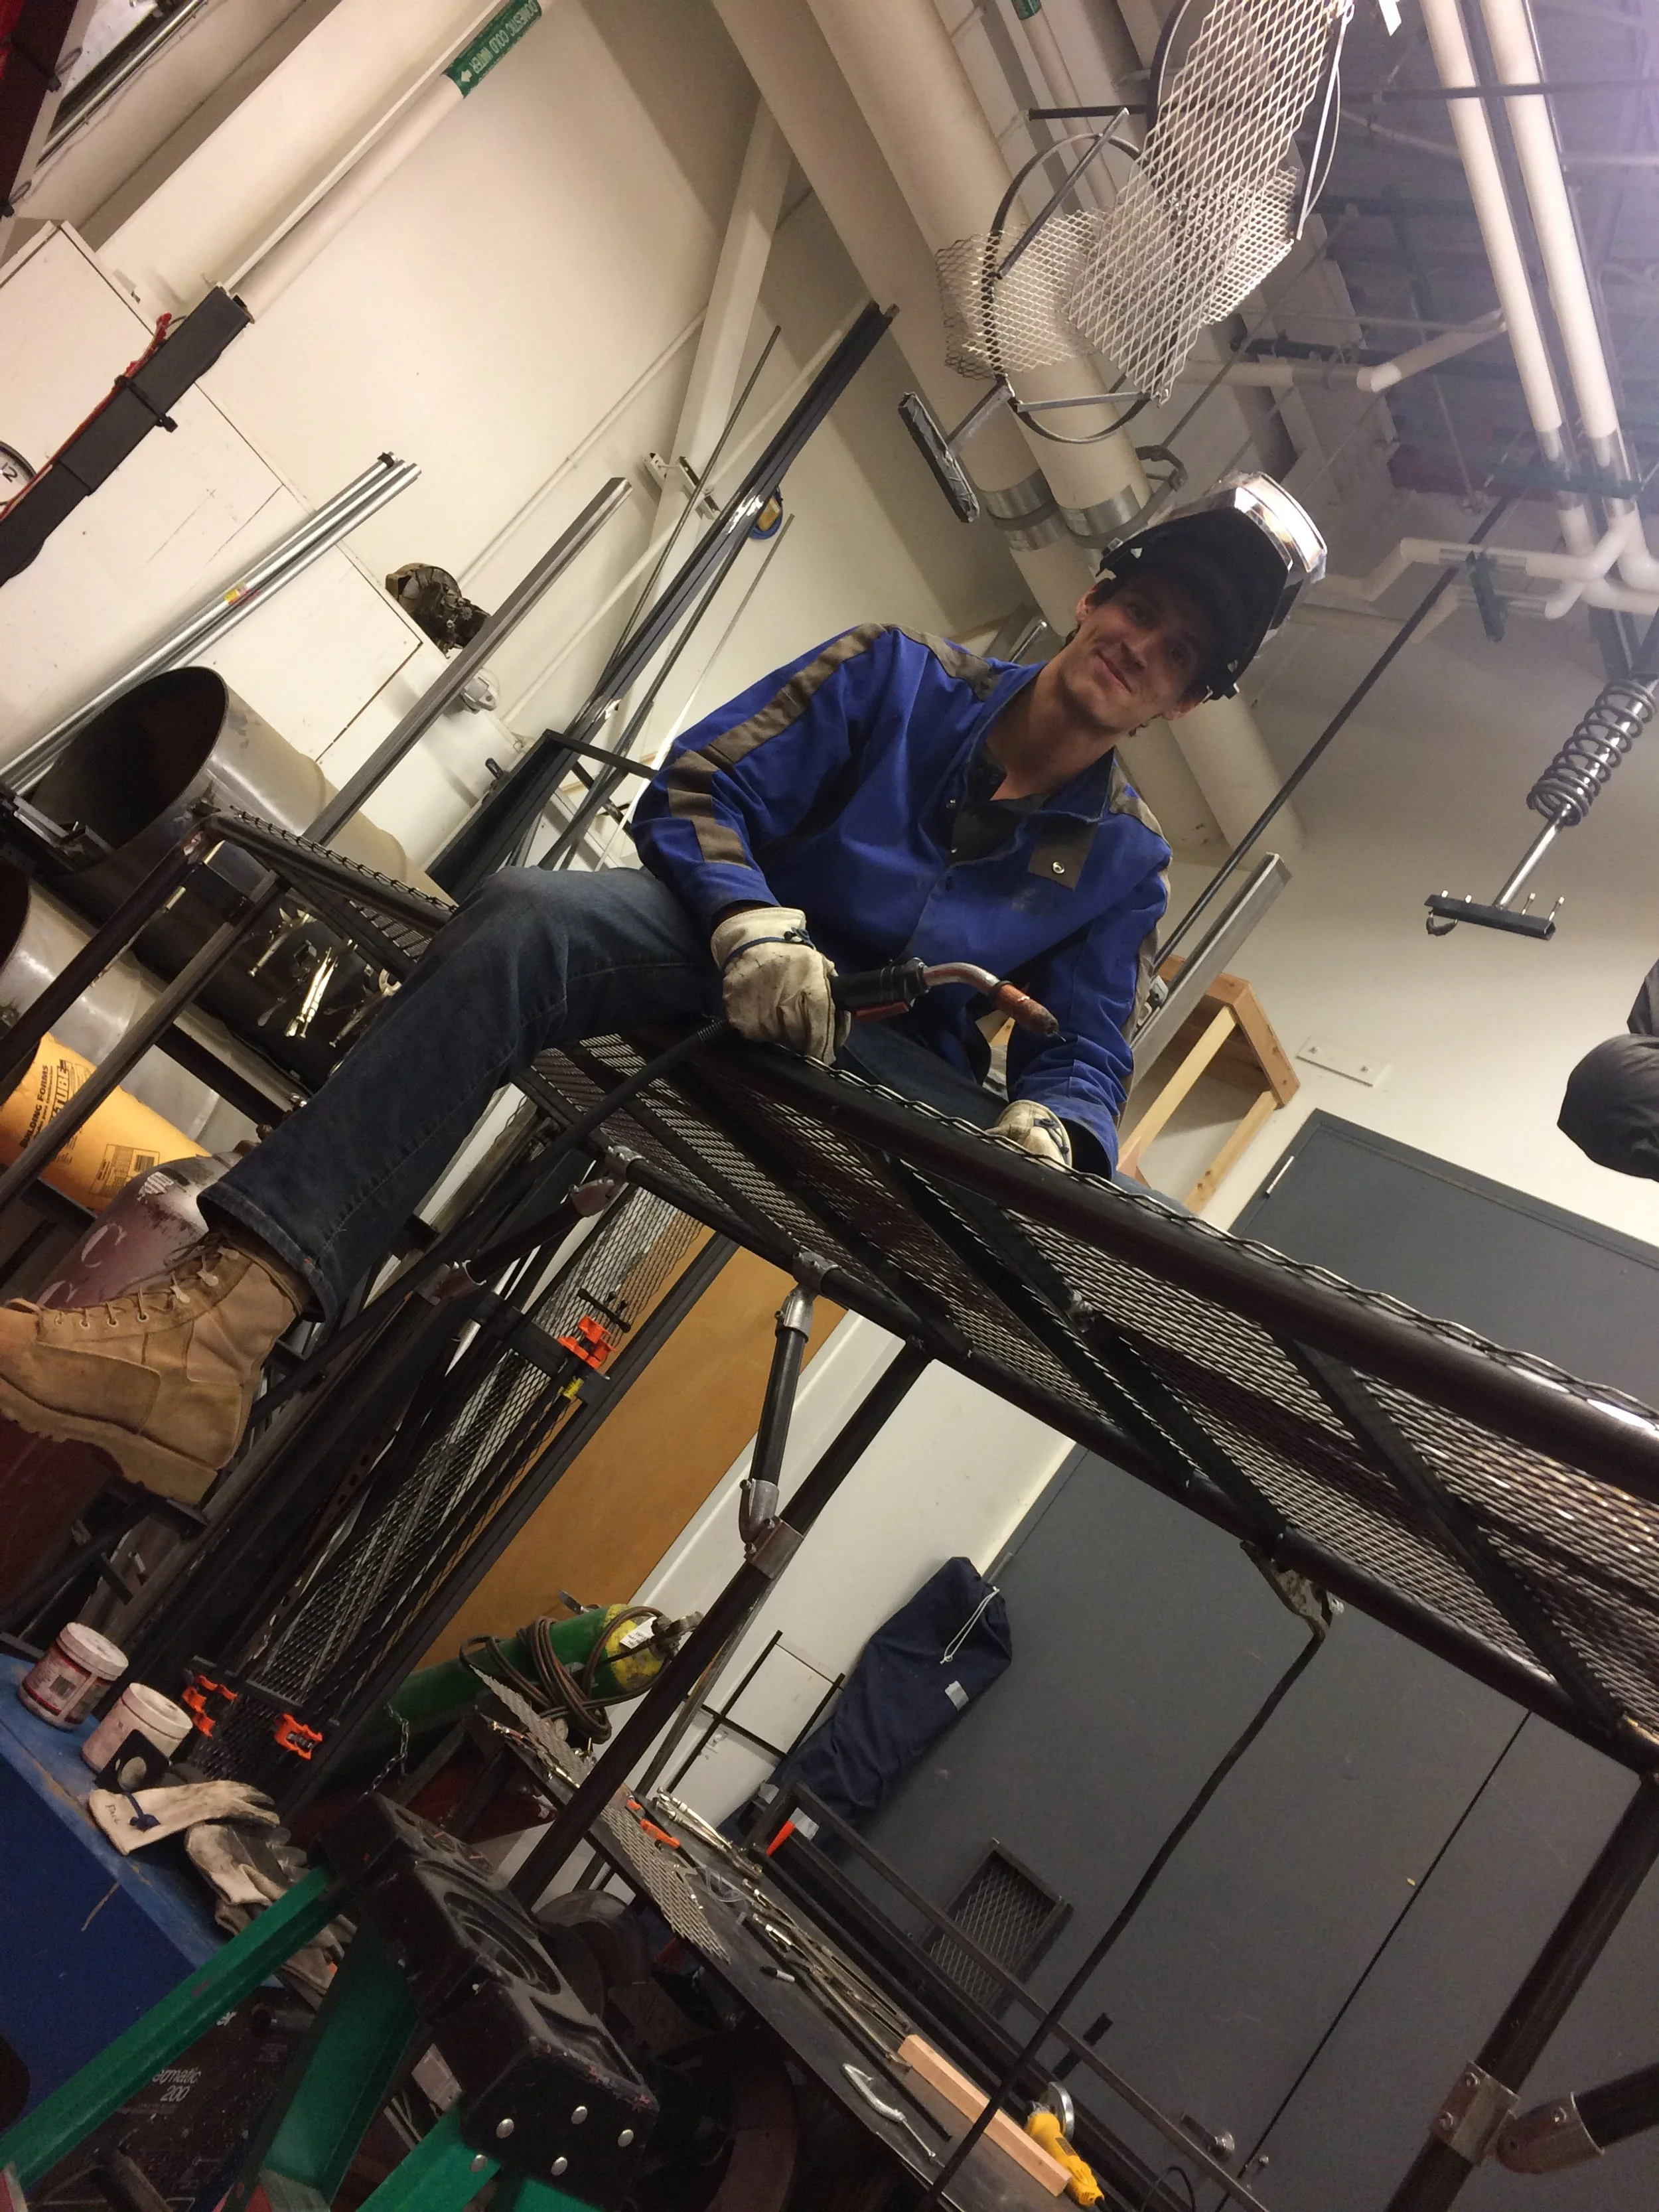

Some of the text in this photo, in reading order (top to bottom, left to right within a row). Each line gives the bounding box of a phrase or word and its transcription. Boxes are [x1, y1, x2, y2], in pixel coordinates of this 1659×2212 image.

[488, 30, 509, 54] COLD
[469, 46, 493, 74] WATER
[1, 462, 18, 483] 12
[19, 1104, 42, 1149] BUILDING
[36, 1064, 48, 1103] FORMS
[160, 2085, 190, 2102] 200
